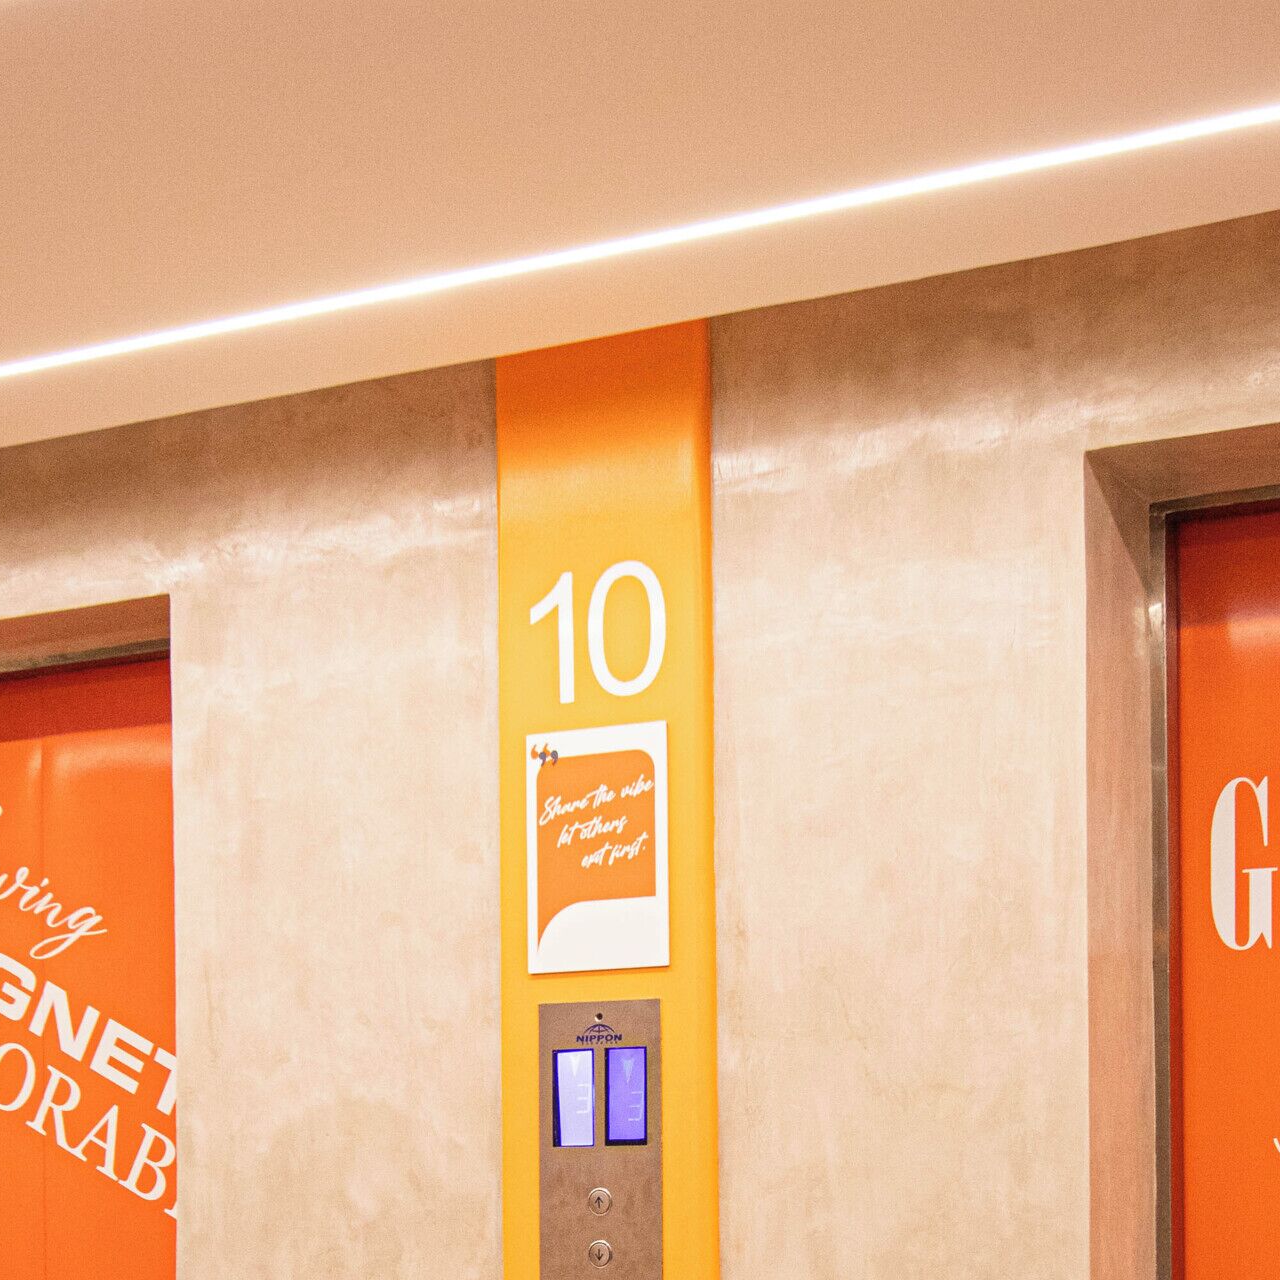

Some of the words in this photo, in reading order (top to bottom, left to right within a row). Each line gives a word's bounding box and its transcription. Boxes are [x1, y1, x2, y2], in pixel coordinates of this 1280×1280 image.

[529, 560, 667, 704] 10
[539, 795, 589, 826] Share
[587, 784, 616, 809] the
[620, 774, 654, 798] vibe
[557, 821, 580, 848] let
[579, 816, 628, 840] others
[581, 842, 610, 869] exit
[576, 1034, 623, 1042] NIPPON
